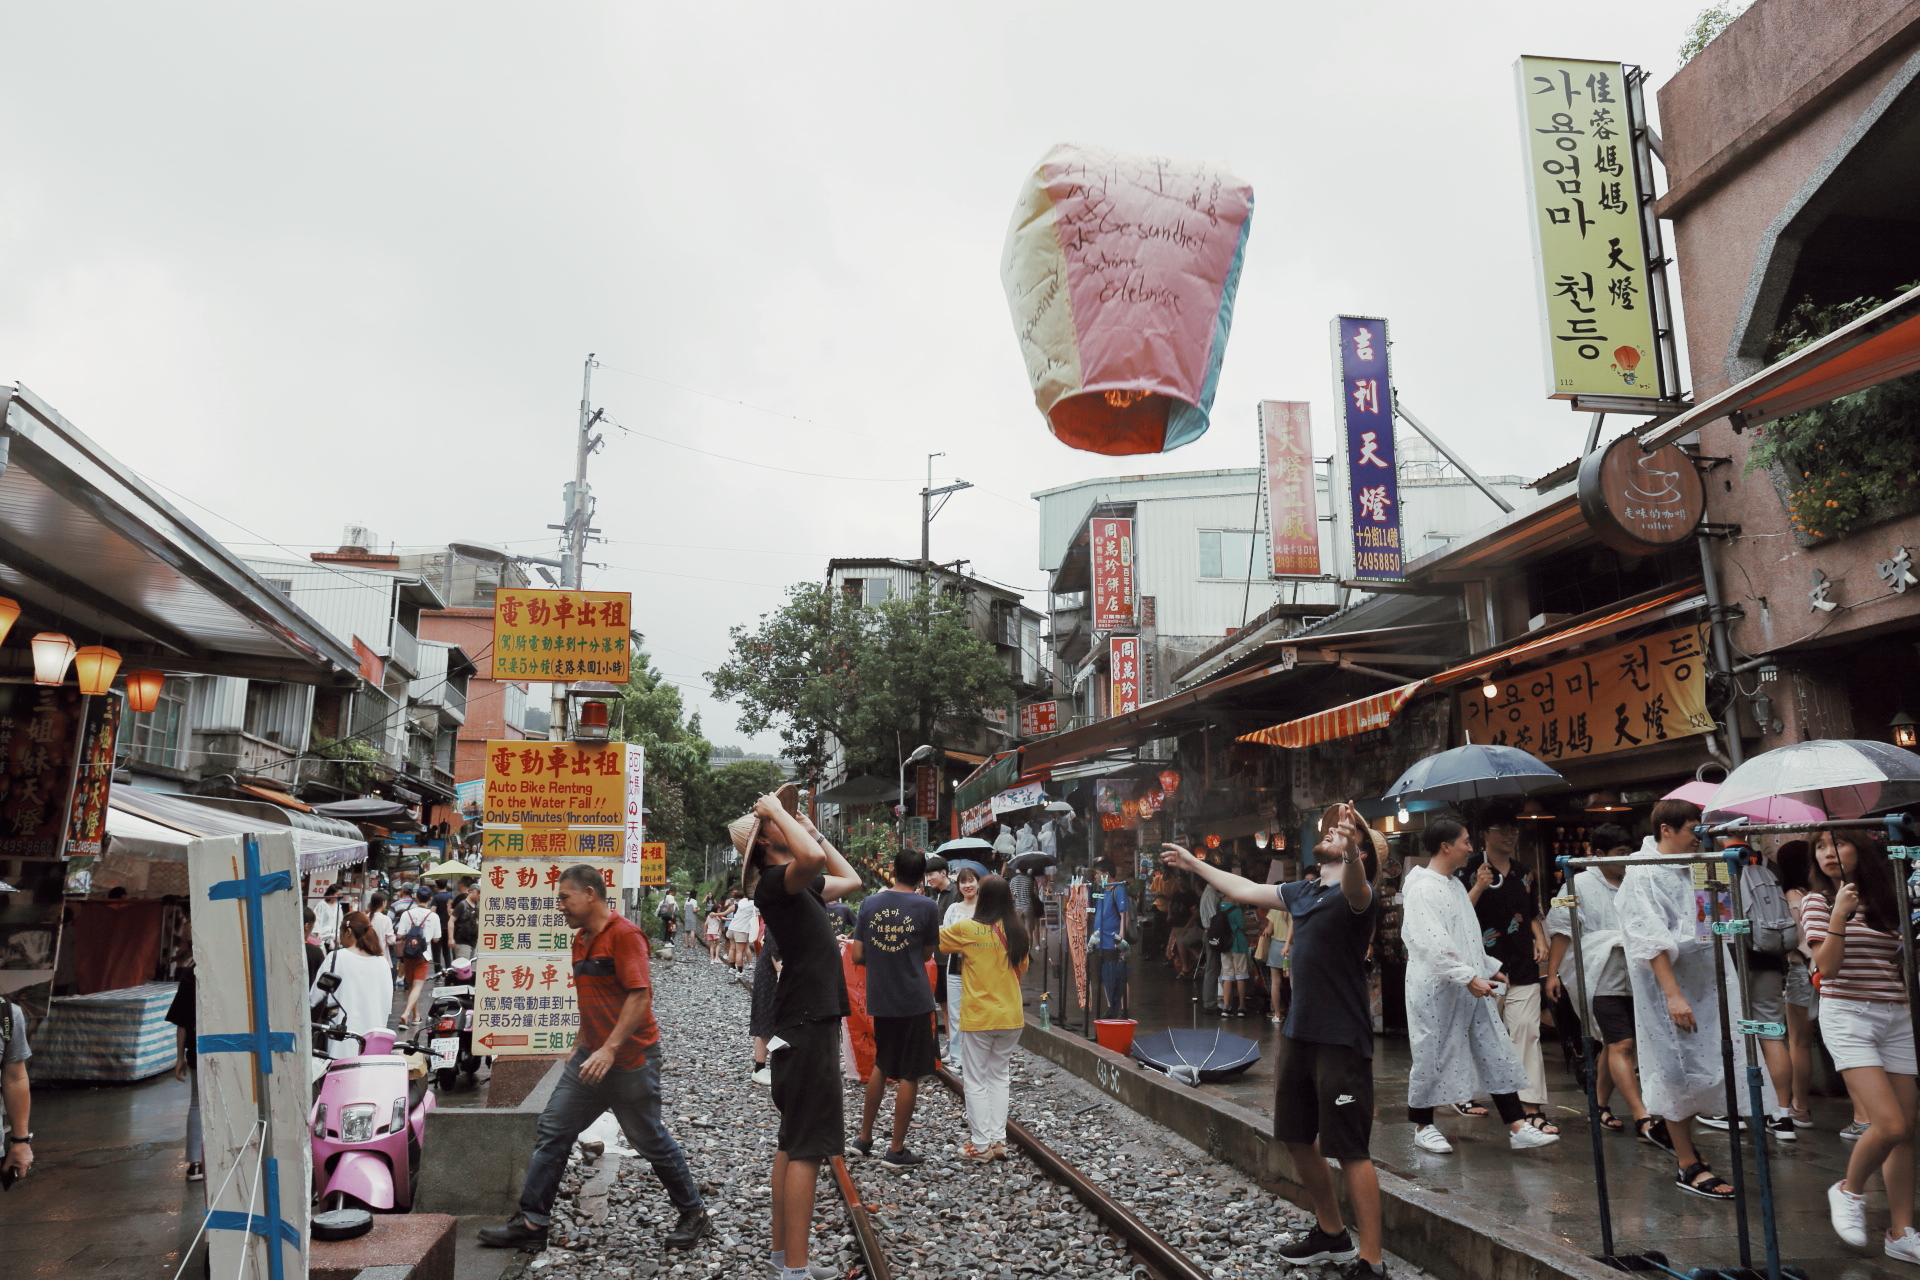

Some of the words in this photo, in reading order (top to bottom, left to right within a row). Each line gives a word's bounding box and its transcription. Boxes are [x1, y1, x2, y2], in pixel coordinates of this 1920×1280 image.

[1531, 69, 1596, 240] 가용엄마
[1585, 71, 1629, 215] 佳蓉媽媽
[1606, 237, 1639, 311] 天燈
[1552, 271, 1608, 360] 천등
[1559, 378, 1574, 387] 112
[1353, 327, 1391, 522] 吉利天燈
[1276, 426, 1312, 541] 天燈工廠
[1624, 507, 1687, 520] 走味的咖啡
[1356, 525, 1398, 548] 十分街114號
[1104, 522, 1120, 612] 周萬珍餅店
[1276, 556, 1318, 568] 2495-8585
[1357, 551, 1400, 571] 24958850
[499, 596, 626, 629] 電動車出租
[498, 633, 626, 654] (駕)騎電動車到十分瀑布
[1618, 633, 1701, 692] 천등
[1614, 692, 1669, 747] 天燈
[12, 689, 58, 836] 三姐妹天燈
[86, 697, 113, 838] 三姐妹天燈
[491, 747, 621, 778] 電動車出租
[488, 781, 517, 793] Auto
[520, 781, 545, 793] Bike
[549, 781, 593, 796] Renting
[488, 795, 504, 808] To
[508, 795, 527, 808] the
[530, 796, 566, 809] Water
[569, 797, 591, 809] Fall
[486, 810, 510, 824] Only
[483, 932, 532, 950] 可愛馬
